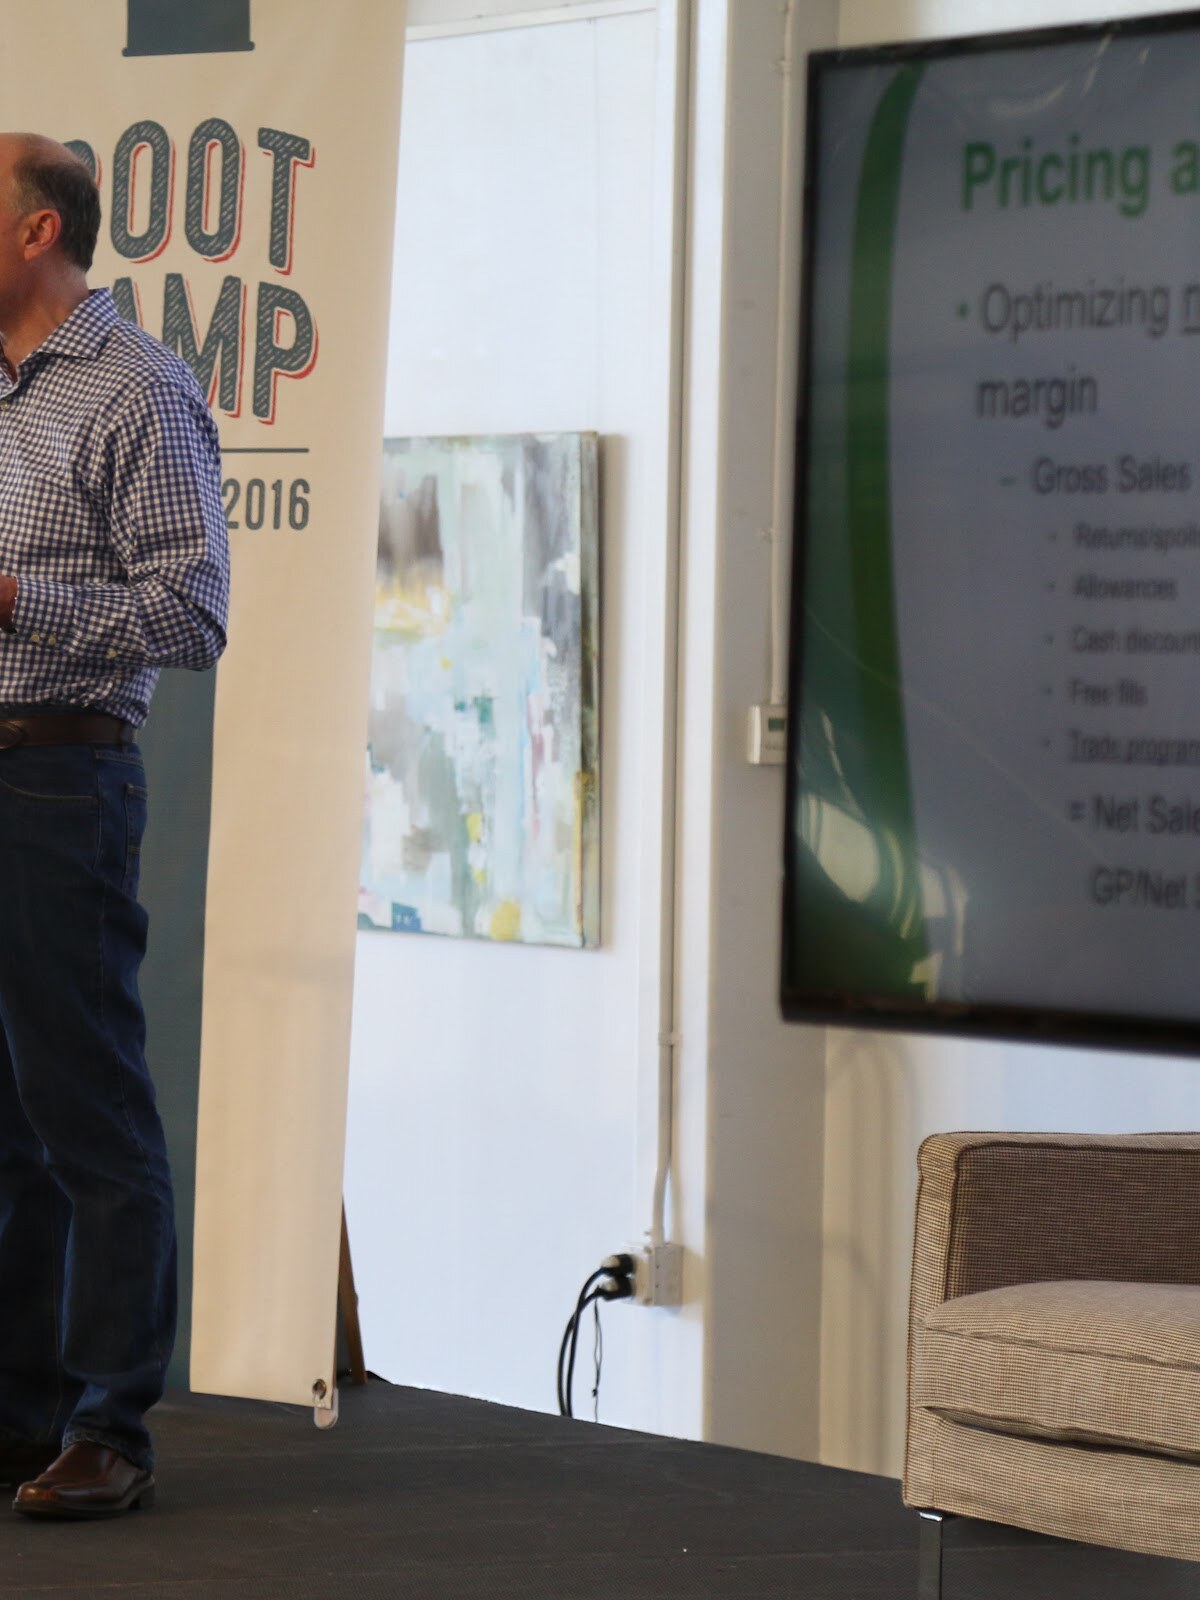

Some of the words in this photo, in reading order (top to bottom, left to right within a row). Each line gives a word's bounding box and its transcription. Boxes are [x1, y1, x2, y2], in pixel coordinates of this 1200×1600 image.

[63, 117, 315, 275] OOT
[961, 132, 1152, 218] Pricing
[981, 279, 1170, 343] Optimizing
[111, 273, 318, 424] MP
[976, 364, 1098, 429] margin
[221, 478, 310, 530] 2016
[1031, 456, 1109, 495] Gross
[1118, 454, 1192, 494] Sales
[1093, 794, 1140, 832] Net
[1145, 794, 1200, 837] Sale
